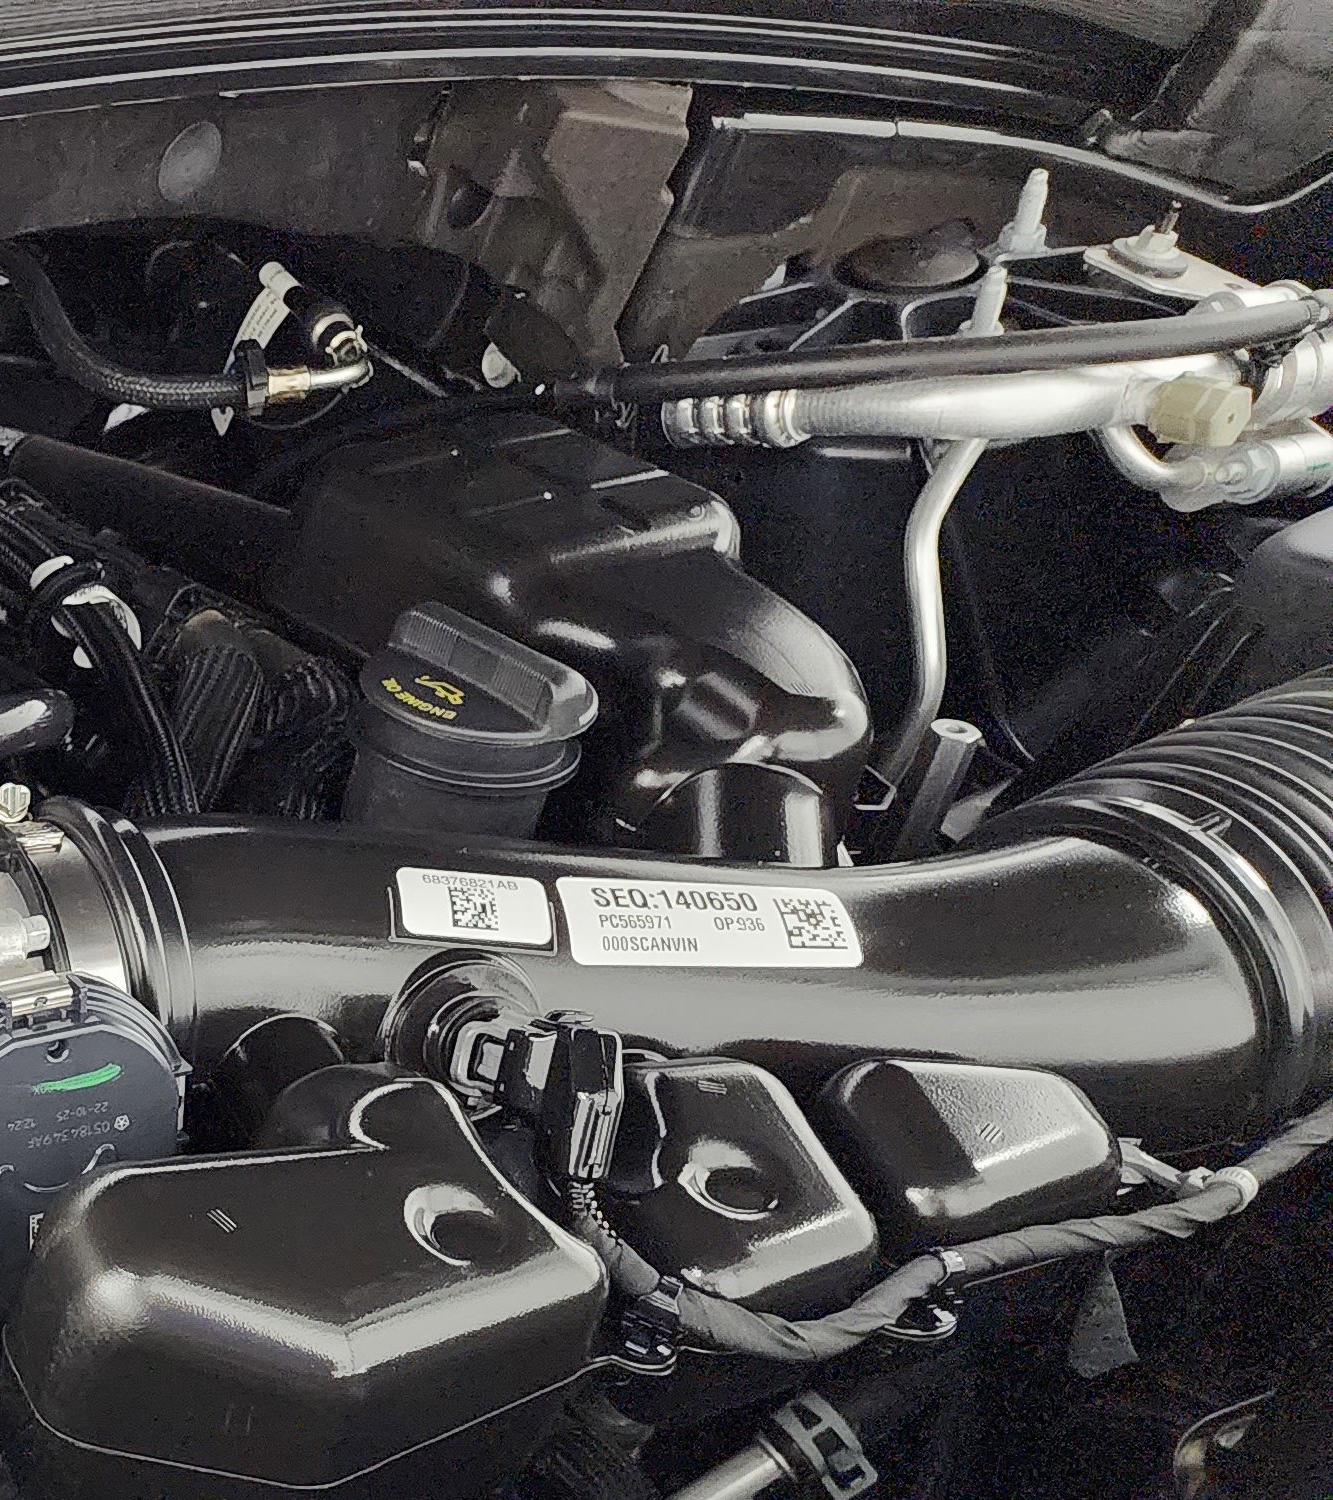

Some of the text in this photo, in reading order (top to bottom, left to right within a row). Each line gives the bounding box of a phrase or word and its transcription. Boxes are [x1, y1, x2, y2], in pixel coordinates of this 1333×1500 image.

[395, 691, 457, 720] ENGINE
[422, 874, 519, 891] 68376821AB
[590, 887, 758, 912] SEQ:140650
[599, 913, 673, 930] PC565971
